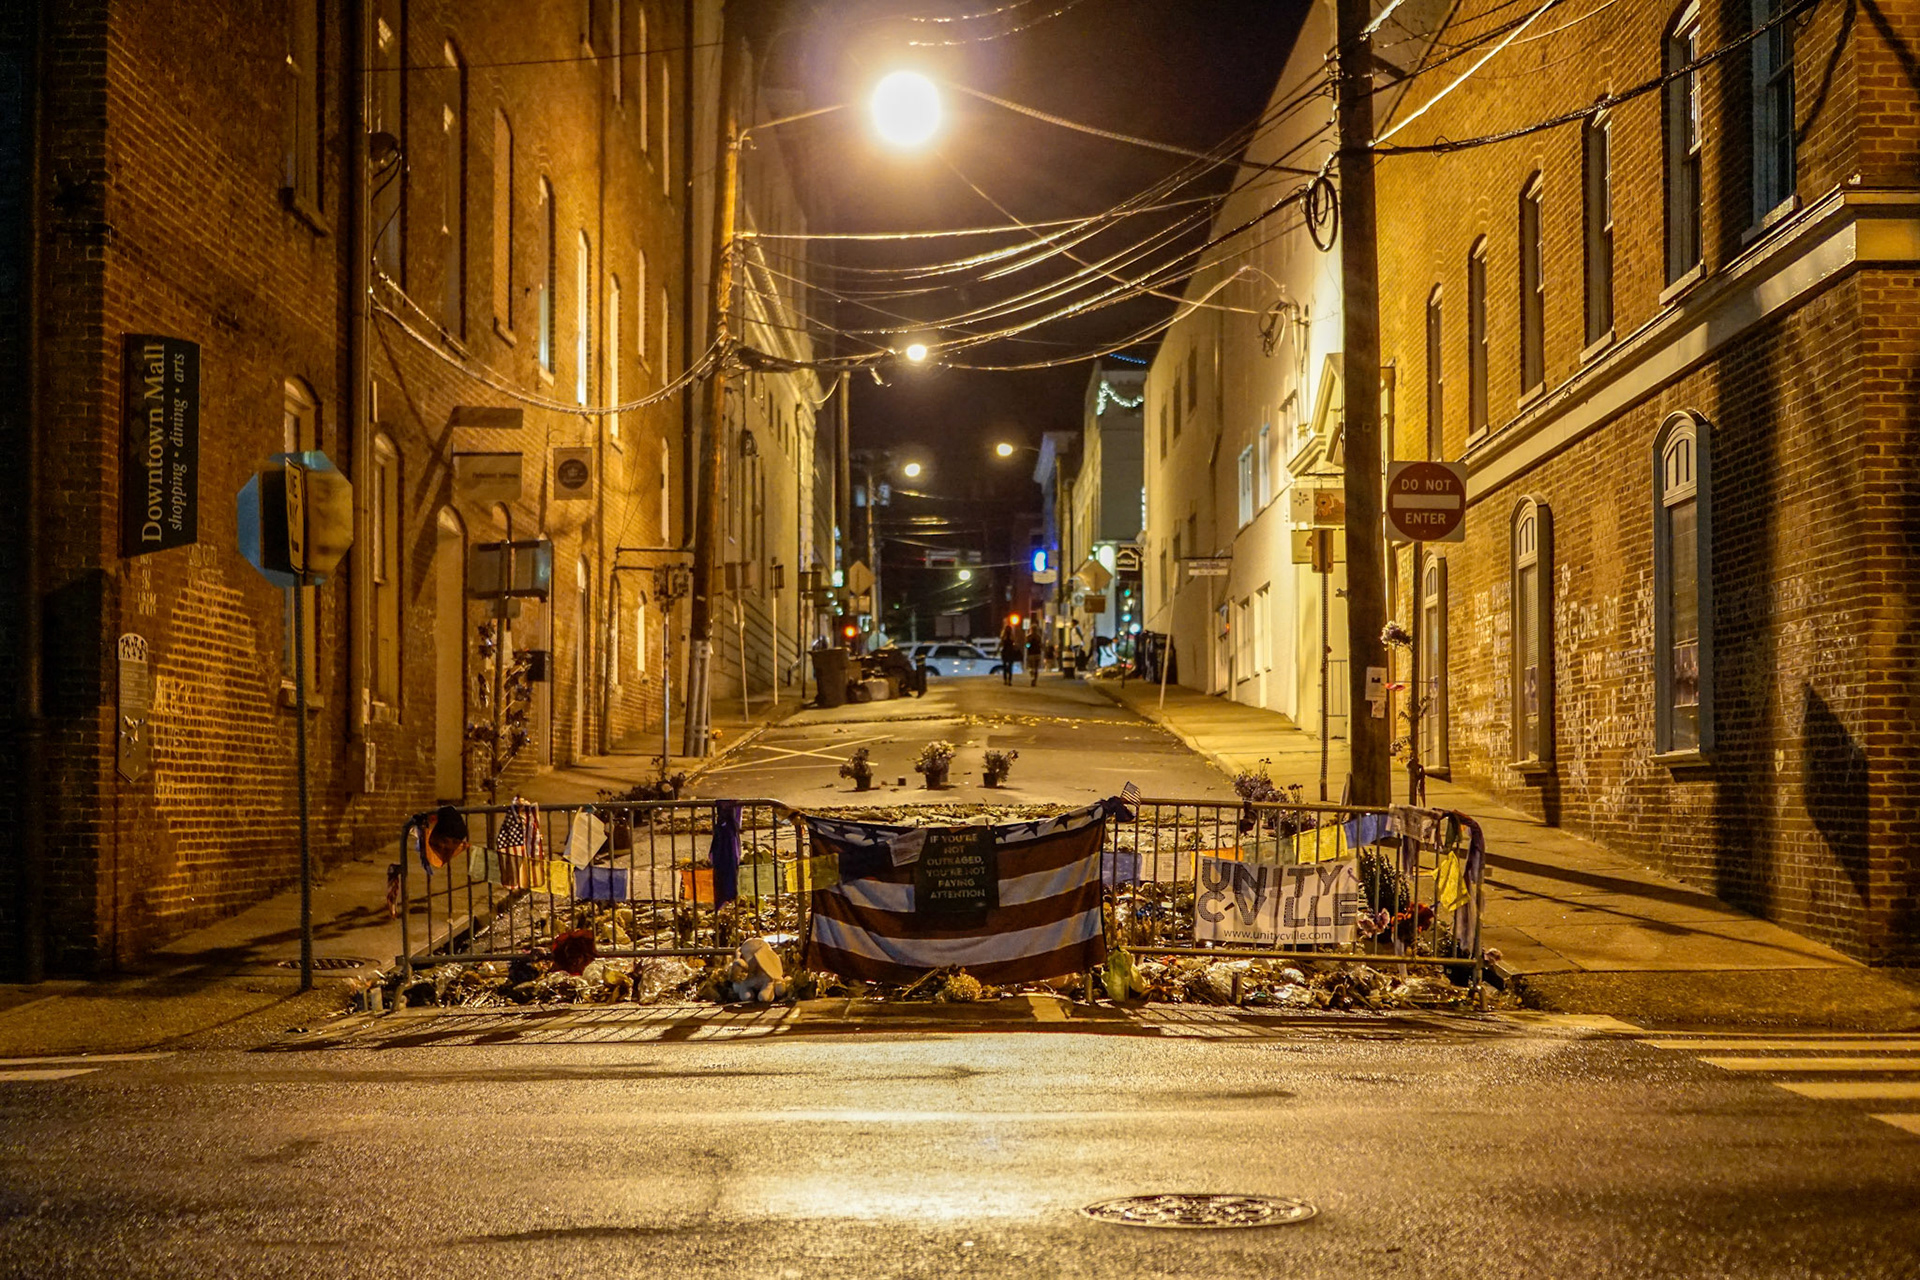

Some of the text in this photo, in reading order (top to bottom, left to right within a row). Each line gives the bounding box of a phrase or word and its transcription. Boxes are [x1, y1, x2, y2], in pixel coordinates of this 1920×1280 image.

[142, 344, 165, 542] Downtown Mall
[168, 353, 188, 531] shopping dining arts
[1401, 479, 1451, 491] DO NOT
[1405, 512, 1446, 524] ENTER
[929, 835, 939, 843] IF
[944, 845, 965, 854] NOT
[938, 878, 976, 888] PAYING
[1202, 858, 1344, 899] UNITY
[930, 888, 986, 899] ATTENTION
[1223, 928, 1332, 941] www.unitycville.com
